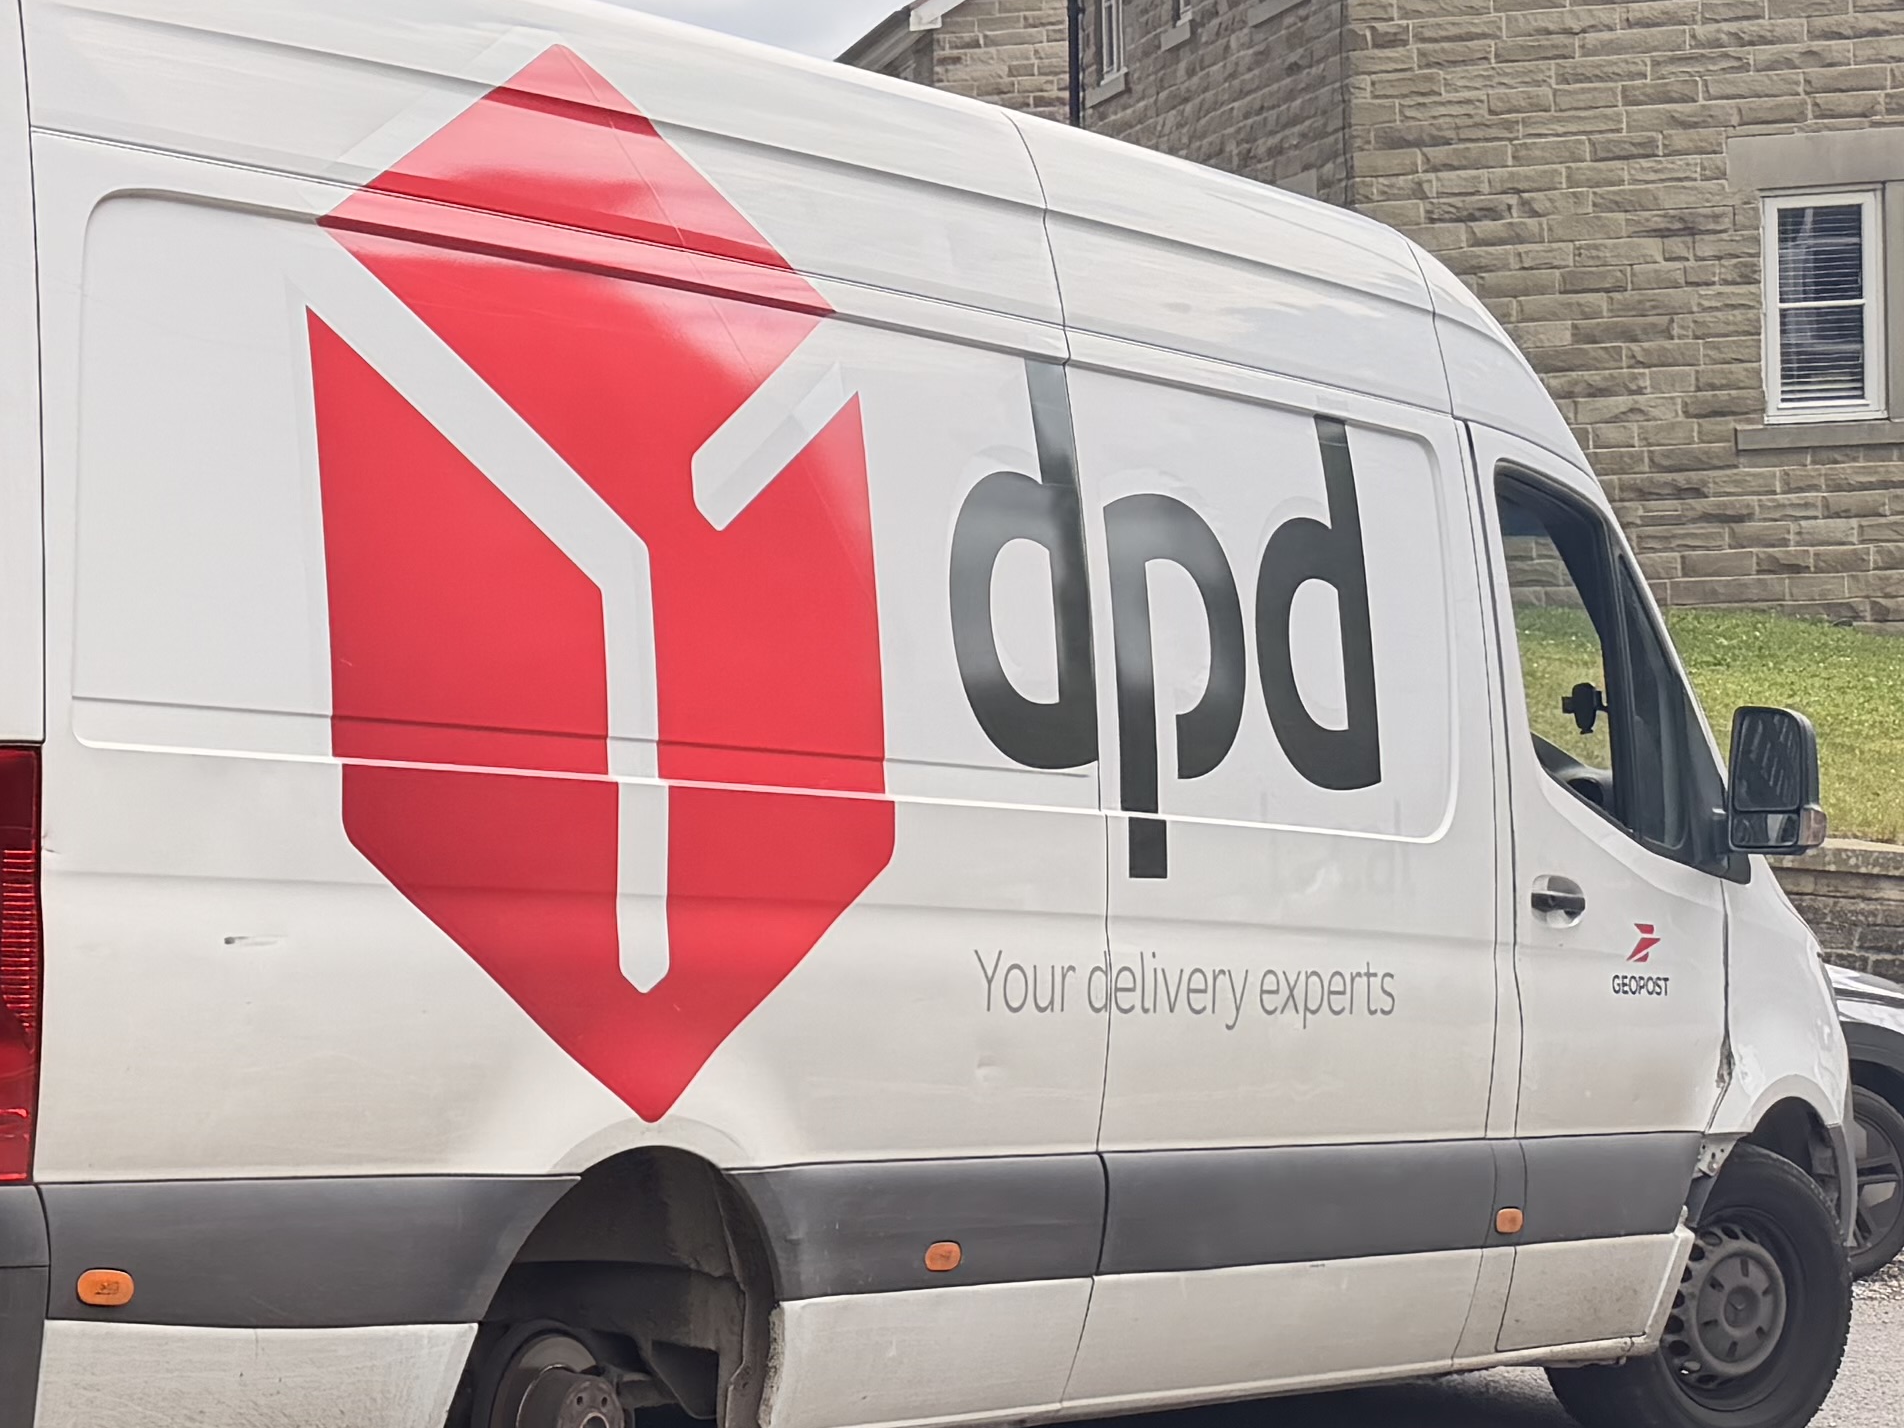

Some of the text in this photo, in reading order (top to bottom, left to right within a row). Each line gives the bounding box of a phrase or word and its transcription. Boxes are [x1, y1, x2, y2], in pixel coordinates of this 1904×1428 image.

[949, 359, 1382, 879] dpd
[974, 948, 1397, 1033] Your delivery experts
[1612, 974, 1670, 996] GEOPOST
